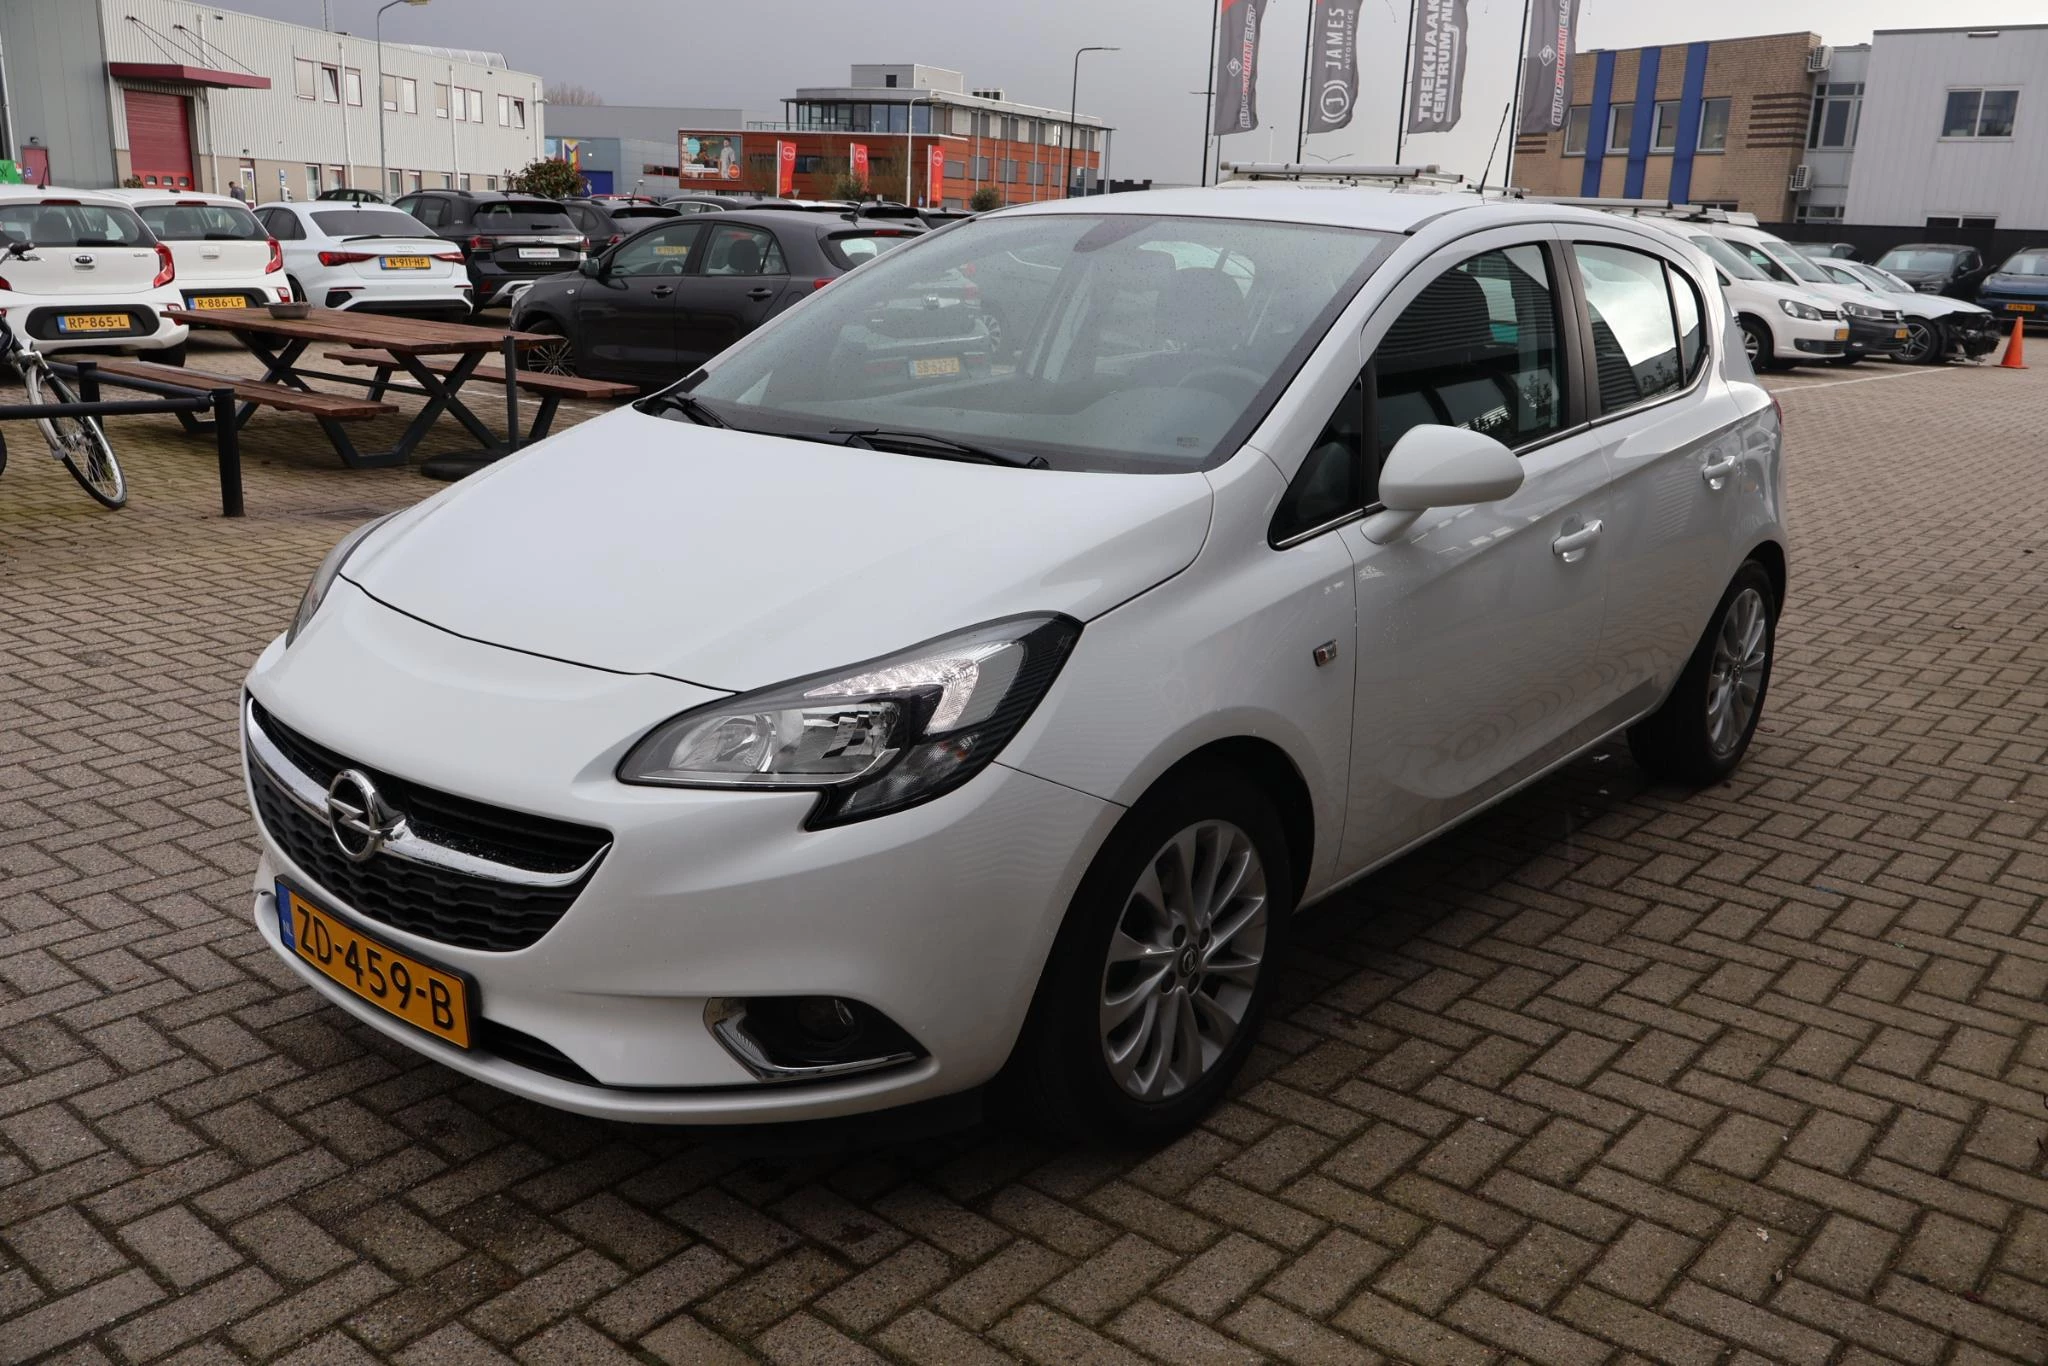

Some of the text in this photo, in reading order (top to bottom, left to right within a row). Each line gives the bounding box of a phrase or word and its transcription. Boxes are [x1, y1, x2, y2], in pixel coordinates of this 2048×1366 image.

[1325, 8, 1345, 70] JAMES
[1345, 9, 1354, 70] AUTOSERVICE
[68, 316, 126, 328] RP-865-L
[282, 919, 294, 937] NL
[297, 904, 454, 1030] ZD-459-B
